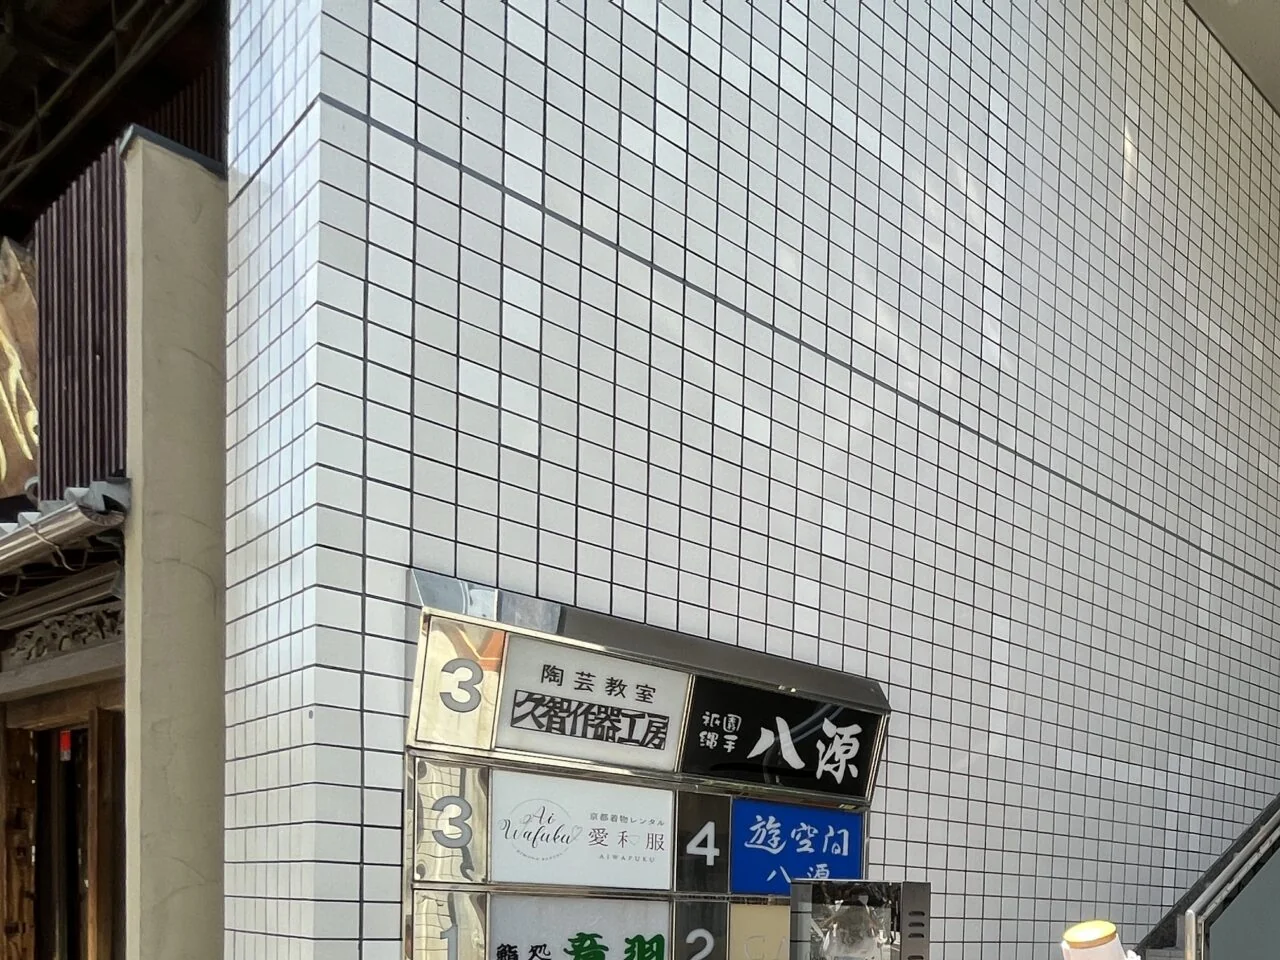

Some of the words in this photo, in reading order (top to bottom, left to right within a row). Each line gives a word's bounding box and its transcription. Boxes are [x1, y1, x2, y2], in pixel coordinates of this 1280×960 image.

[439, 658, 484, 713] 3
[541, 664, 657, 704] 陶芸教室
[511, 689, 669, 750] 久智作器工房
[747, 715, 862, 786] 八源
[432, 795, 472, 848] 3
[520, 806, 555, 825] Ai
[589, 812, 665, 826] 京都着物レンタル
[744, 815, 849, 856] 遊空間
[599, 854, 656, 863] AIWAFUKU
[686, 821, 720, 866] 4
